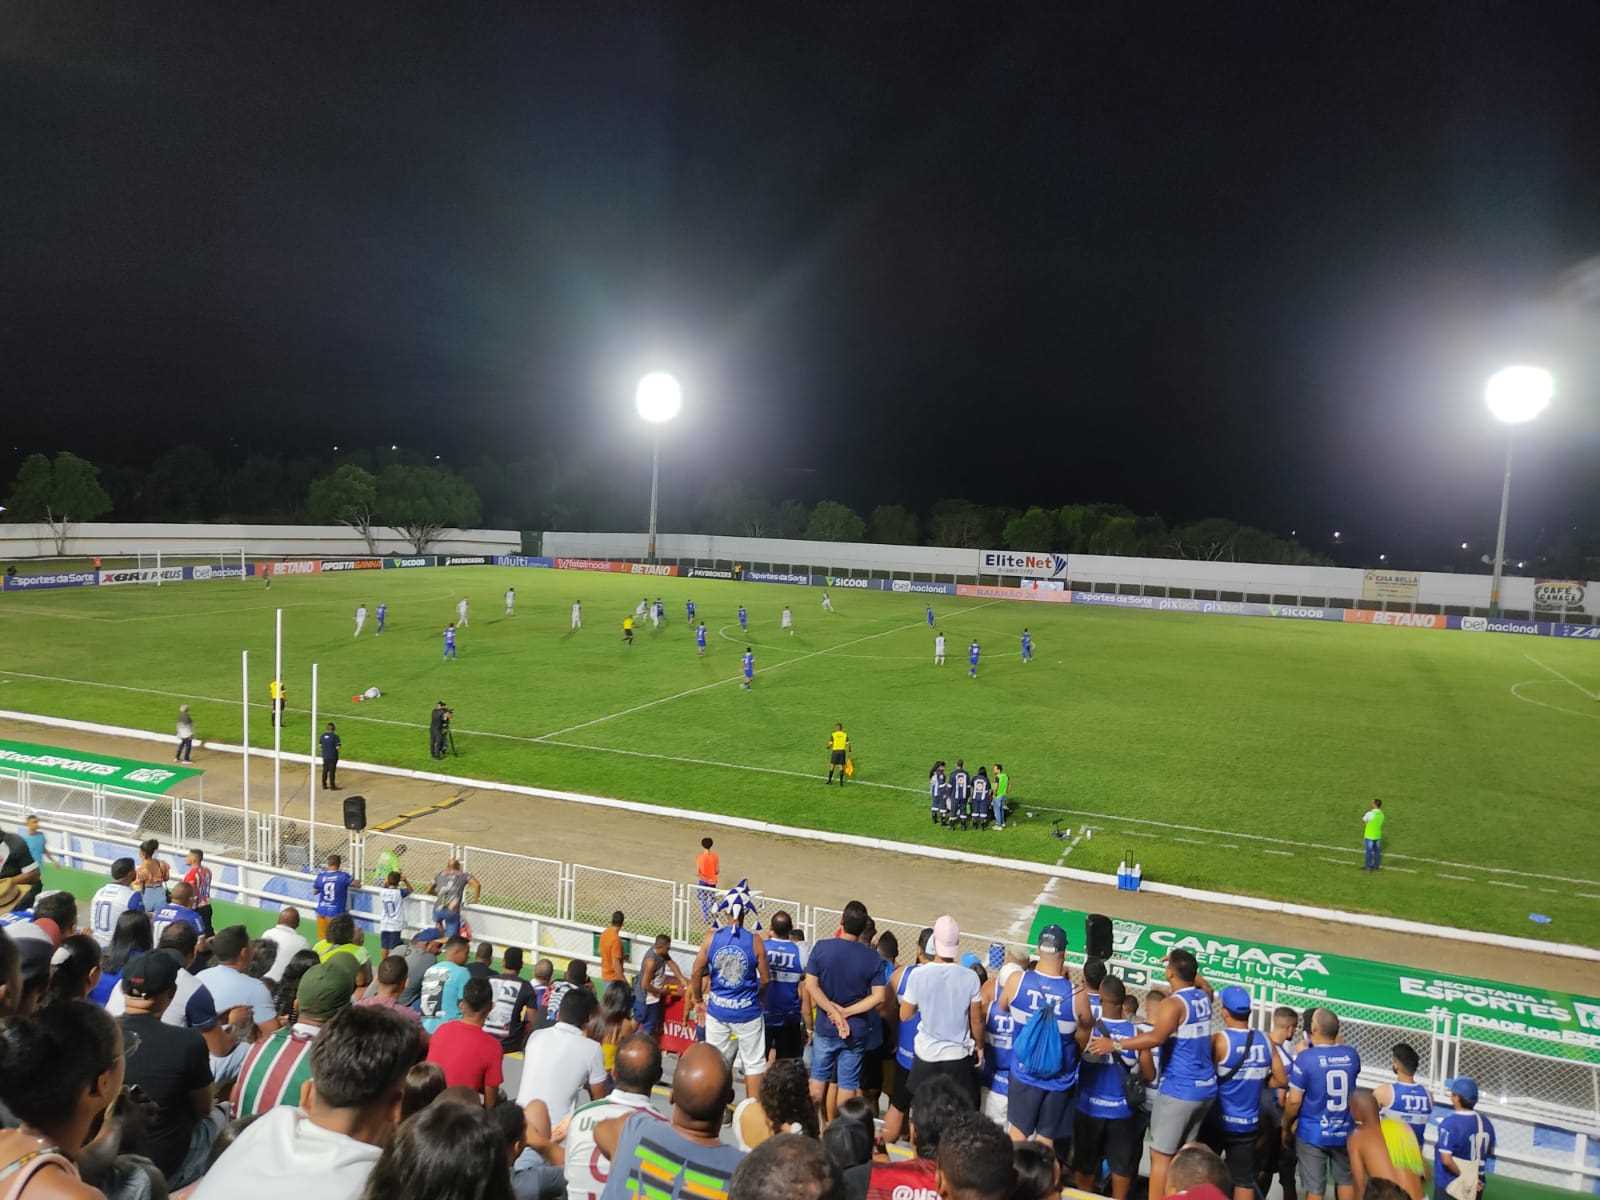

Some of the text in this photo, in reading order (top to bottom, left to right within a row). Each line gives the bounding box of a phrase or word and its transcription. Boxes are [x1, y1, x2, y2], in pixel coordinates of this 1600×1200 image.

[274, 561, 315, 575] BETANO
[499, 557, 528, 567] Multi
[631, 563, 671, 576] BETANO
[985, 553, 1053, 569] EliteNet
[835, 578, 868, 588] SICOOB
[1281, 607, 1325, 618] SICOOB
[1372, 611, 1436, 628] BETANO
[323, 881, 336, 902] 9
[95, 899, 113, 933] 10
[767, 950, 796, 969] TJI
[1149, 930, 1330, 976] CAMACÃ
[1399, 976, 1572, 1023] ESPORTES
[1433, 979, 1538, 1004] SECRETARIA
[1326, 1069, 1349, 1112] 9
[1401, 1094, 1429, 1112] TJI
